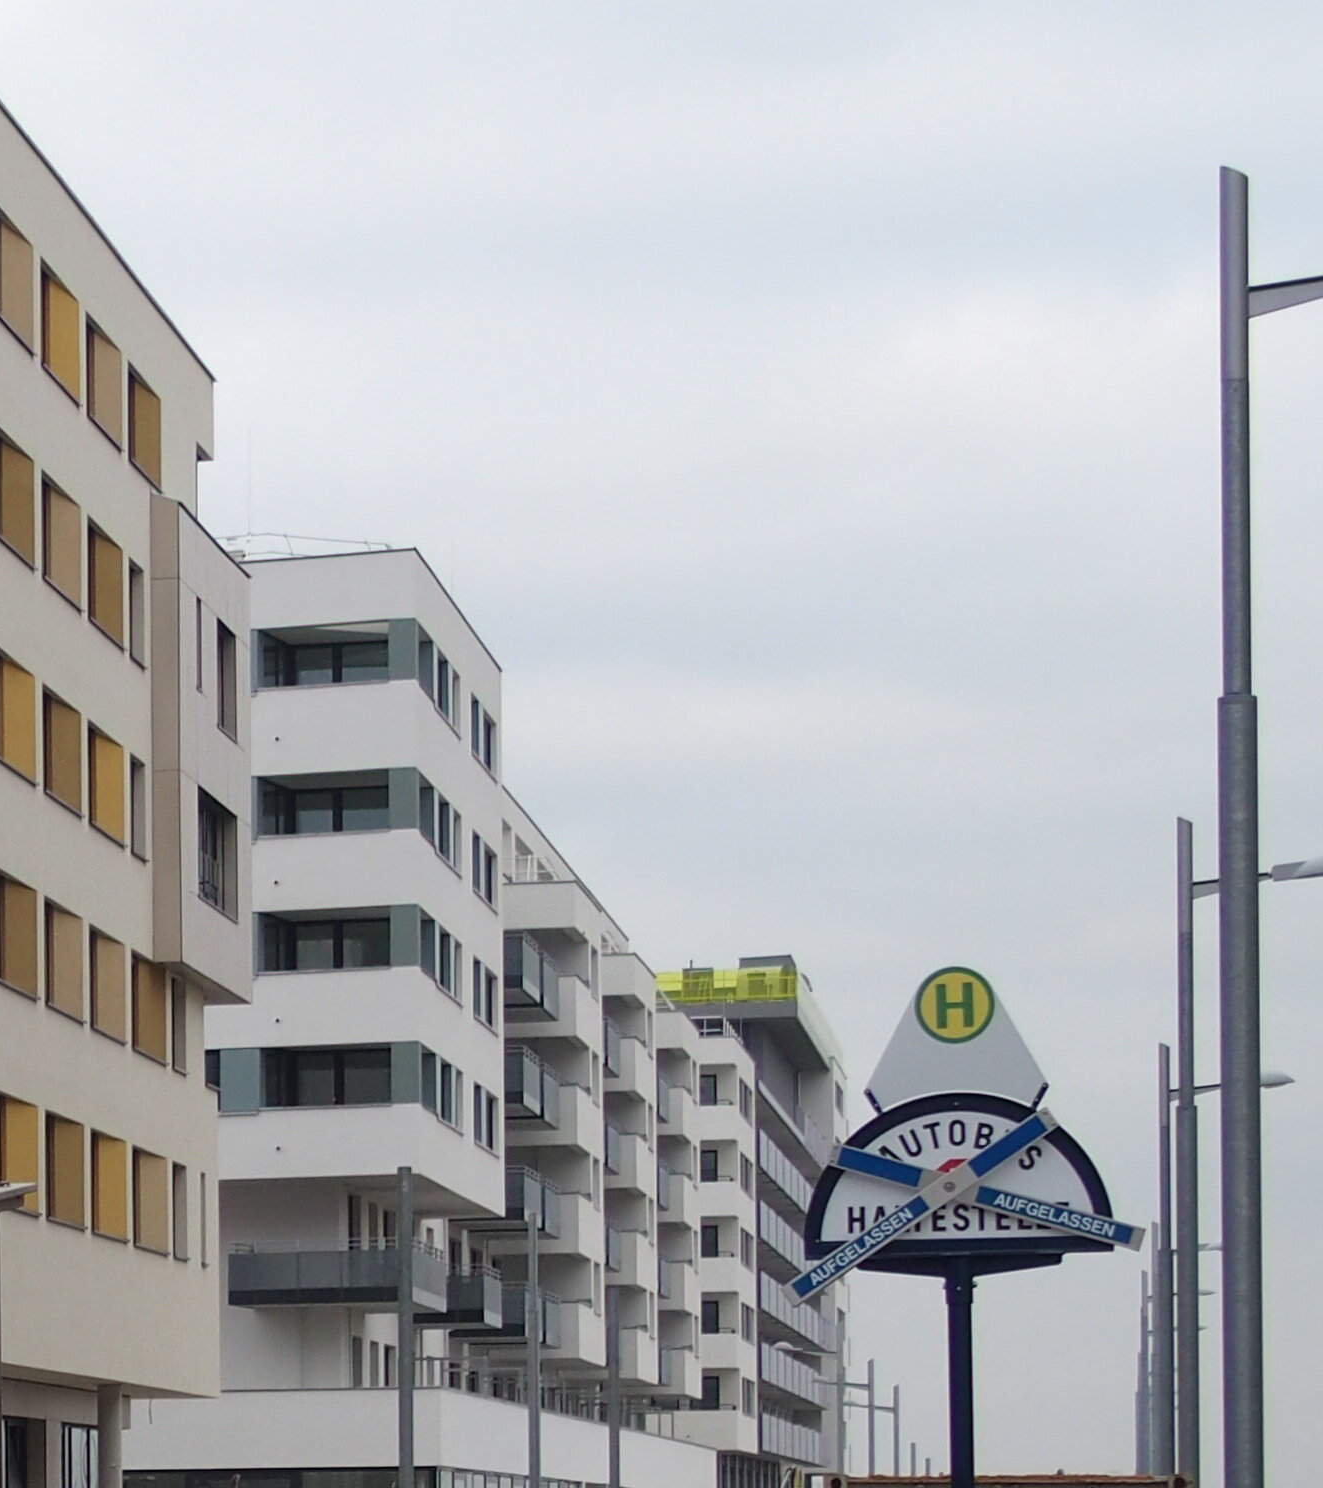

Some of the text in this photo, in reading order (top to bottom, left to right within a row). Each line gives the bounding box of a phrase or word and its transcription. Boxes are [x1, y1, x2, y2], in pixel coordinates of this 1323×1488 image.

[935, 981, 975, 1029] H
[878, 1119, 1043, 1171] AUTOBS
[993, 1192, 1116, 1238] AUFGELASSEN
[809, 1207, 914, 1287] AUFGELASSEN
